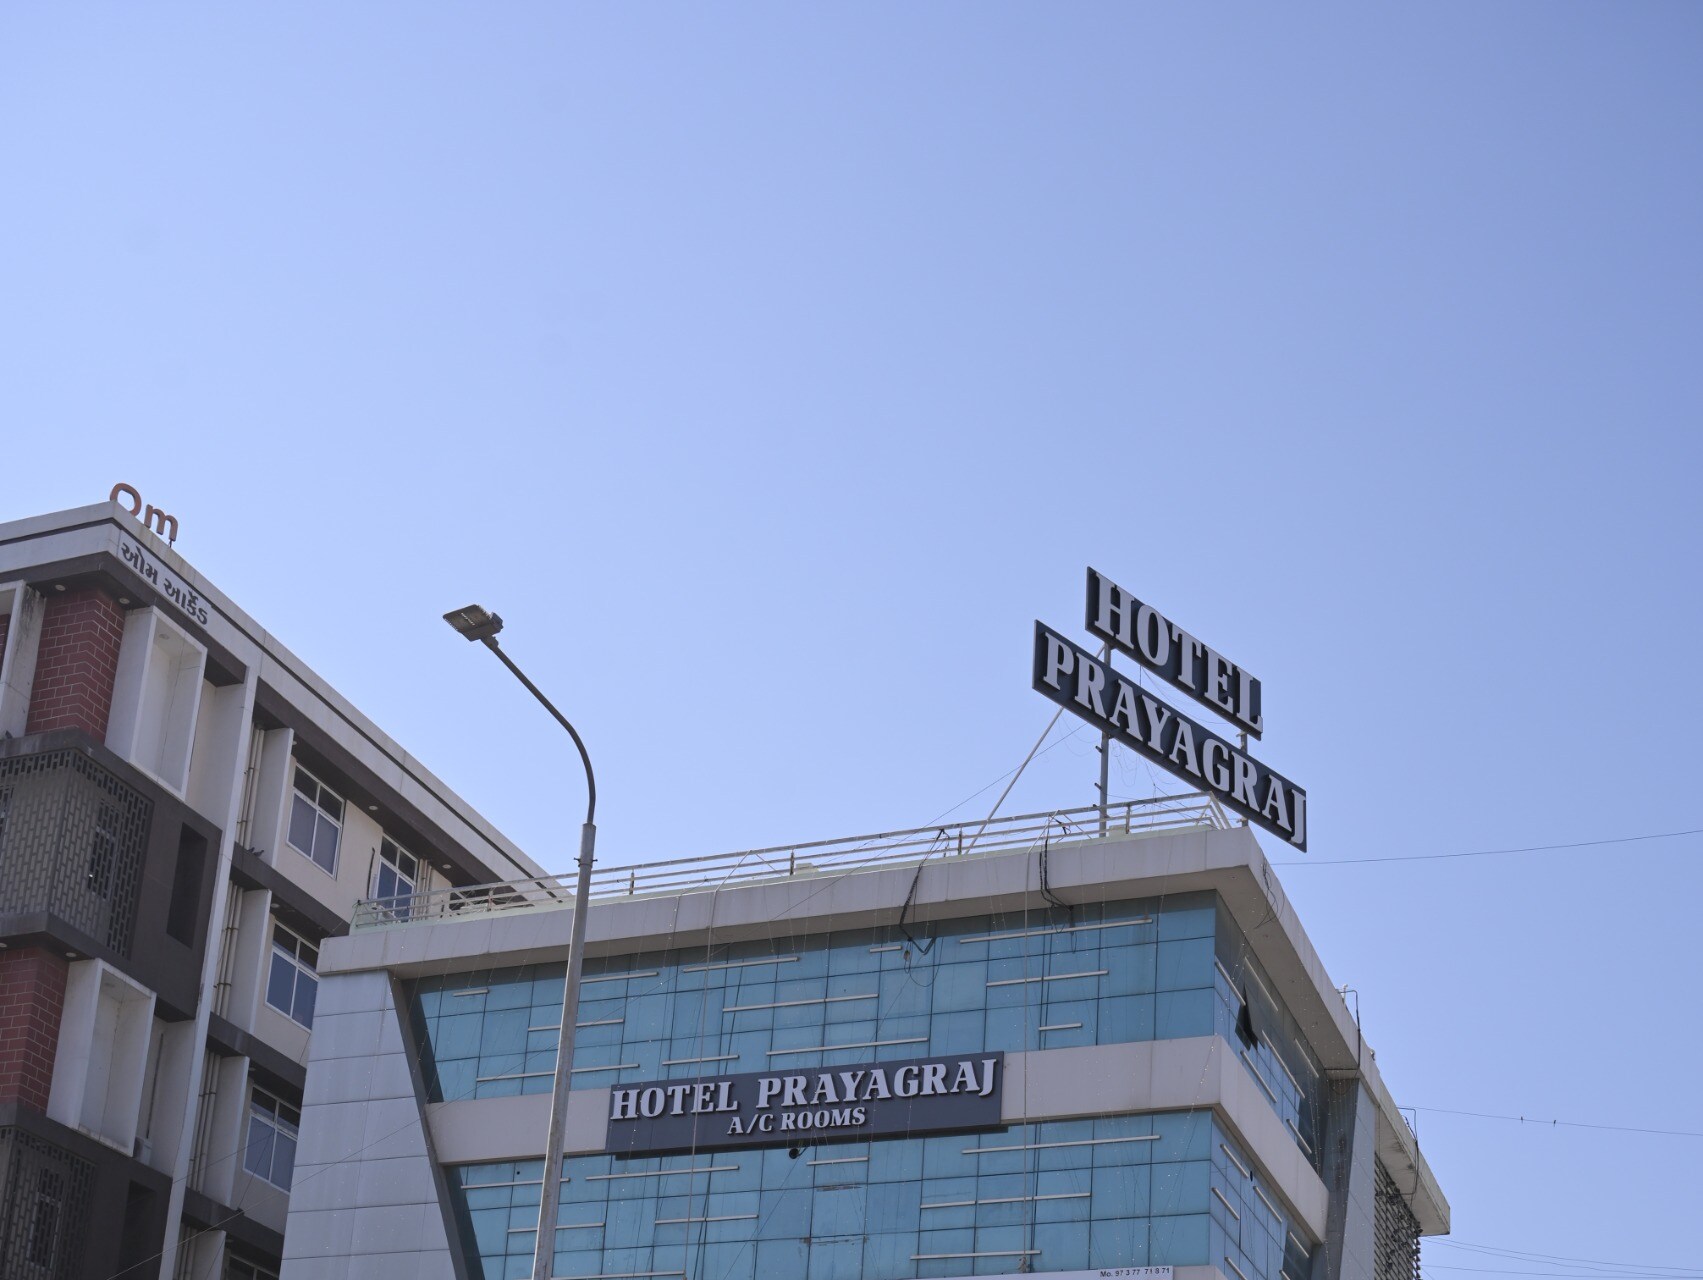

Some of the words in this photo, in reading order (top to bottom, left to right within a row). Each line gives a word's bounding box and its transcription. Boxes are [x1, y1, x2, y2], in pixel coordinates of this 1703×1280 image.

[109, 483, 178, 541] Om
[117, 543, 158, 585] ઓમ
[1094, 573, 1263, 733] HOTEL
[1043, 632, 1305, 844] PRAYAGRAJ
[611, 1081, 738, 1120] HOTEL
[756, 1058, 997, 1109] PRAYAGRAJ
[727, 1113, 774, 1135] A/C
[780, 1106, 866, 1131] ROOMS
